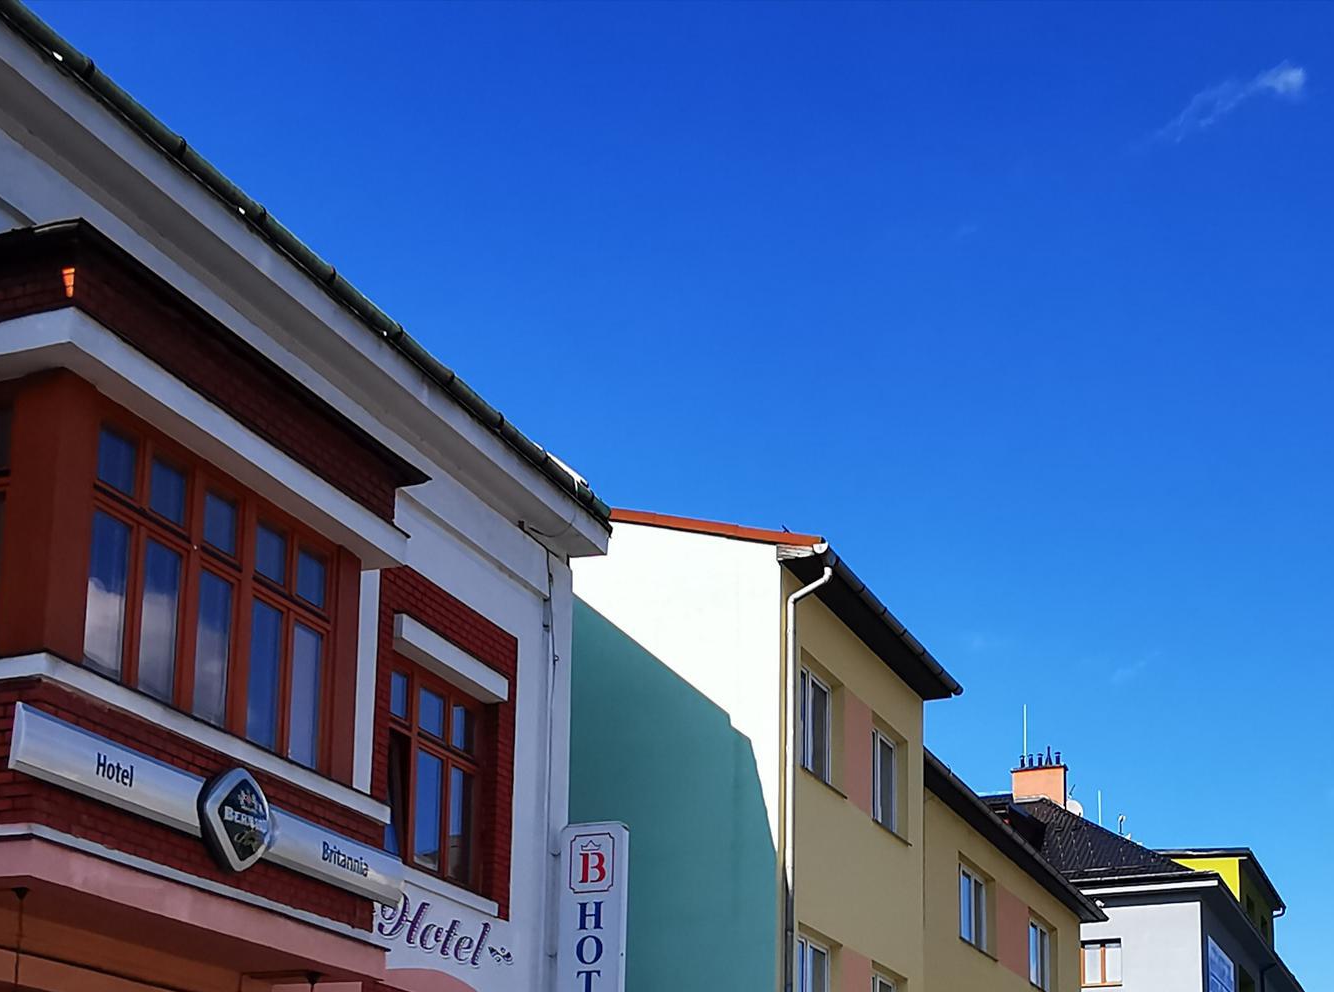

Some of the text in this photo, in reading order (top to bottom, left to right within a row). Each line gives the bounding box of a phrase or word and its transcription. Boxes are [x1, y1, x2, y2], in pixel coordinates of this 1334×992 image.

[96, 751, 369, 876] Hotel Britannia
[578, 852, 607, 884] B
[378, 893, 491, 966] Hotel
